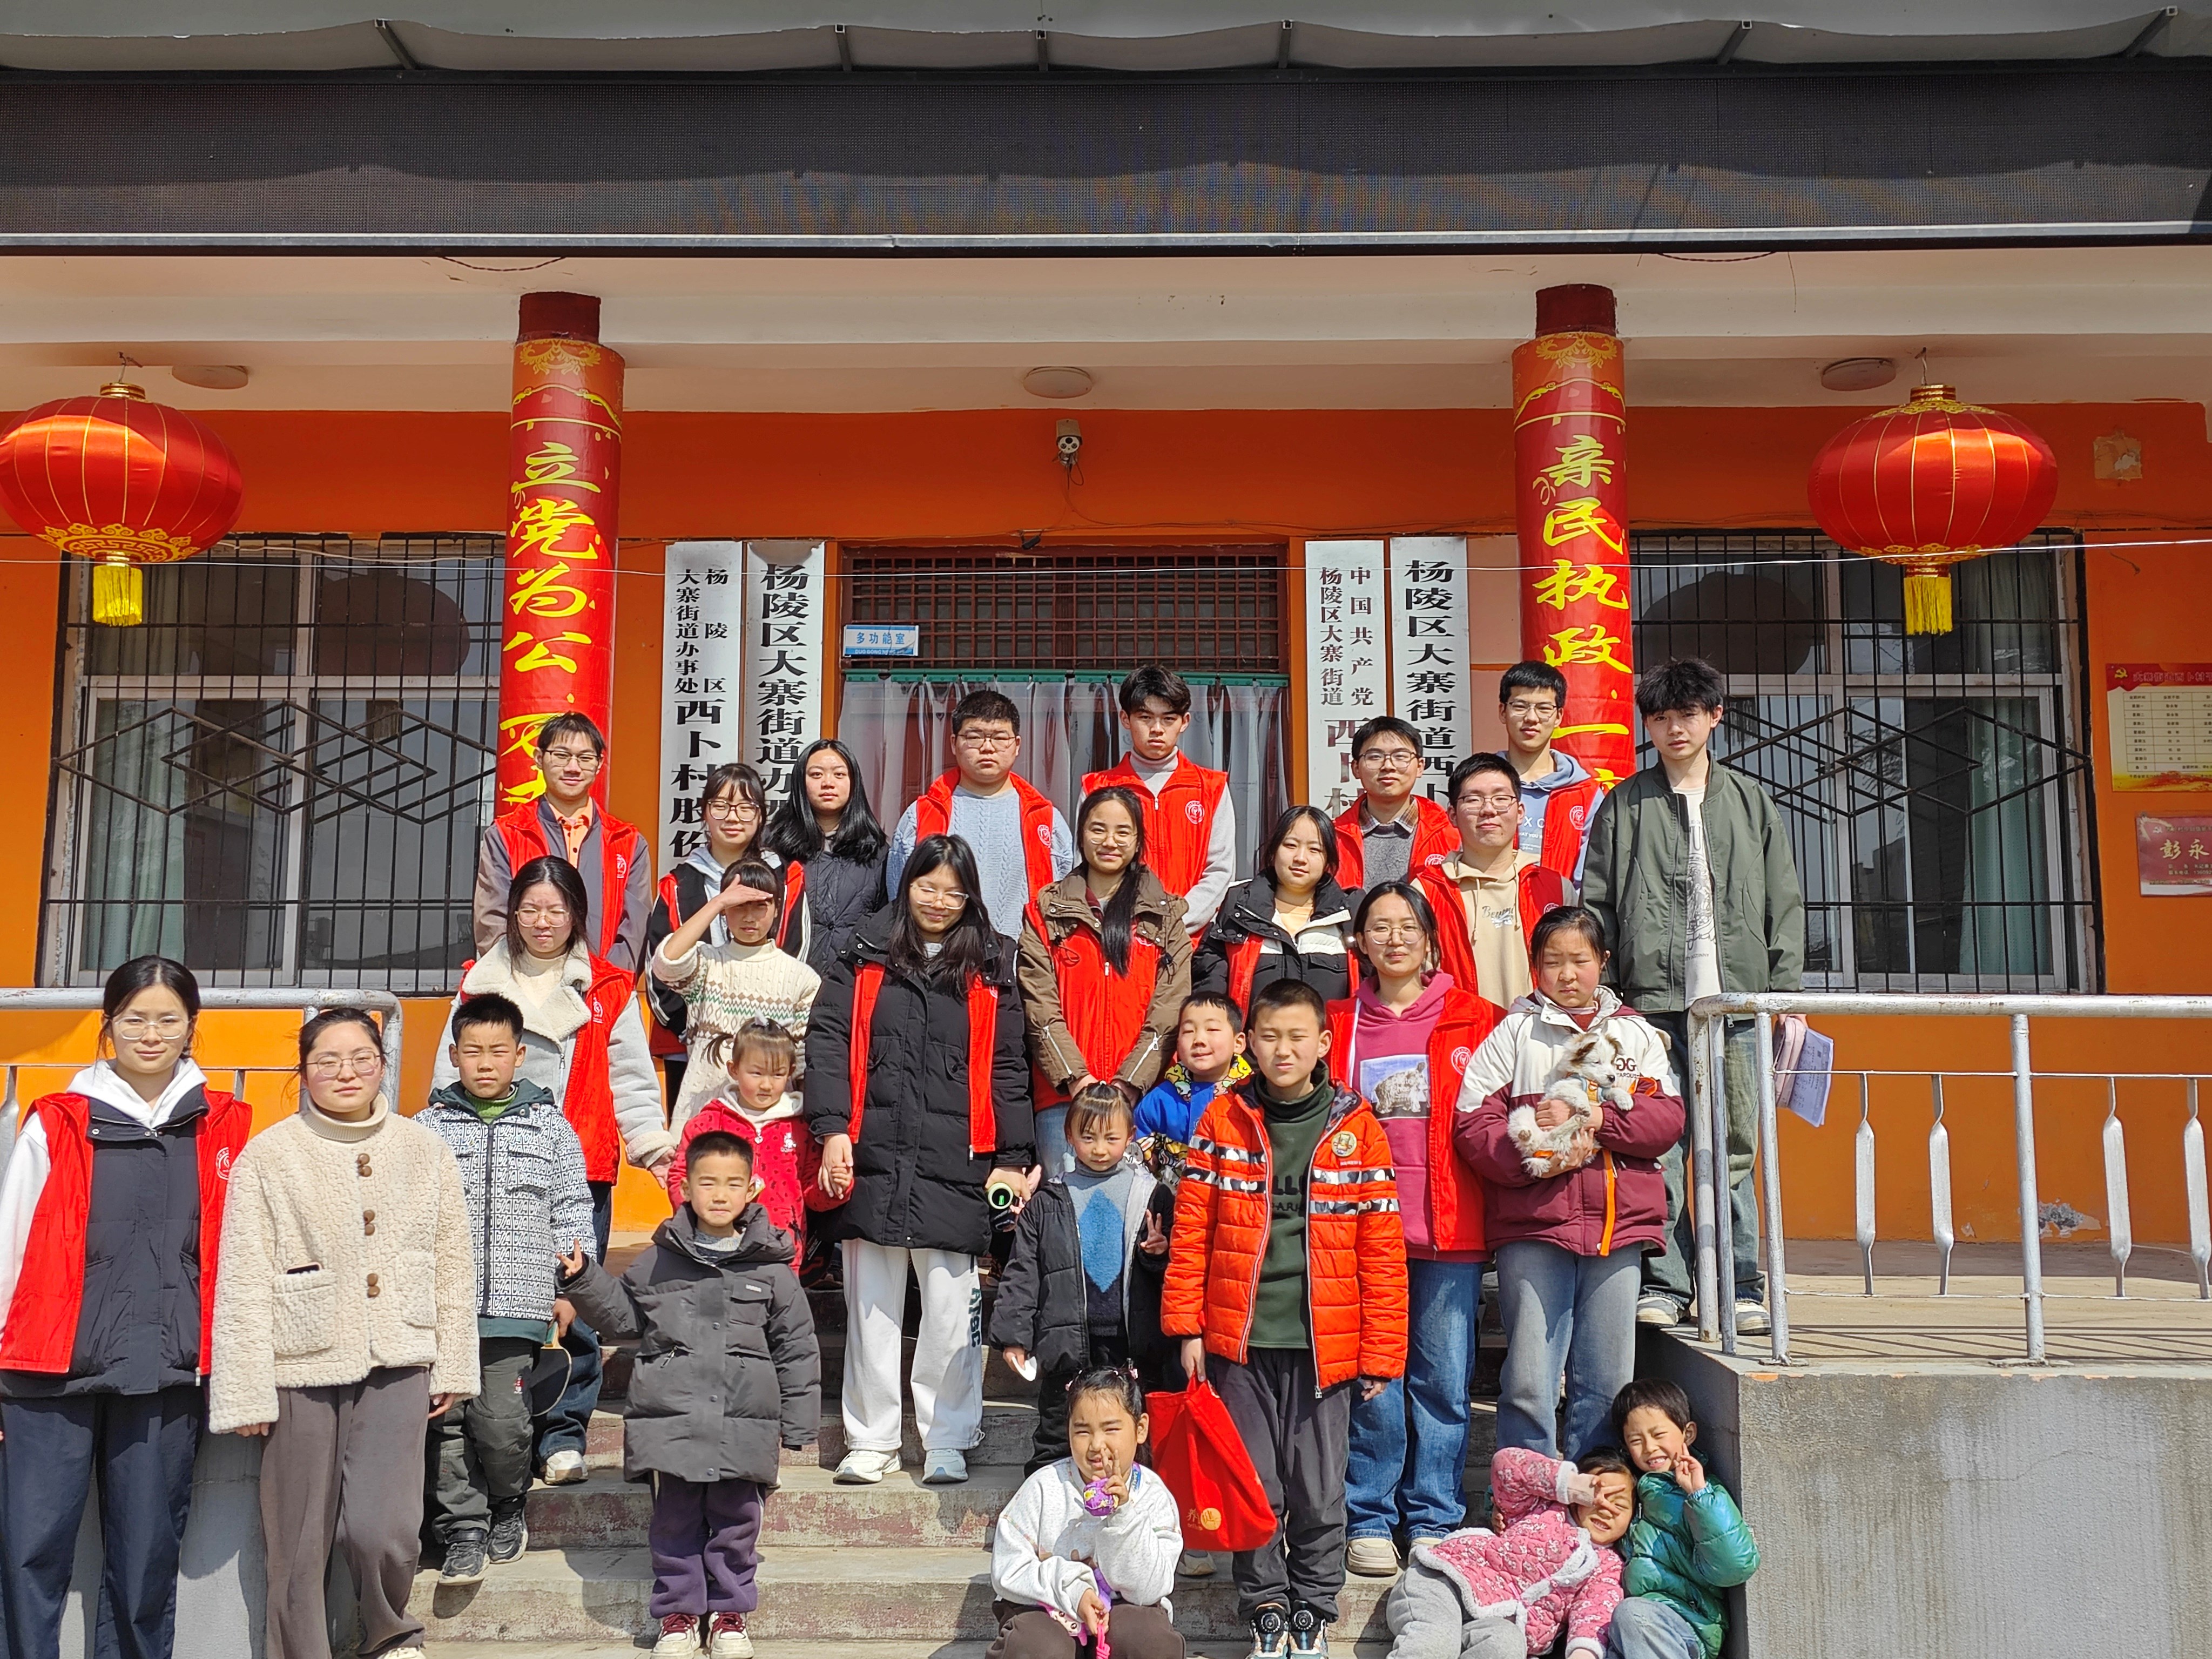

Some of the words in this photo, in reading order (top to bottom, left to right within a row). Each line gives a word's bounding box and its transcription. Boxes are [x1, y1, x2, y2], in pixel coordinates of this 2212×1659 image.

[503, 441, 601, 674] 立党为公
[1533, 435, 1633, 674] 亲民执政
[675, 569, 700, 694] 大寨街道办事处
[704, 569, 729, 693] 杨陵区
[857, 632, 905, 644] 多功能室
[1319, 567, 1344, 705] 杨陵区大寨街道
[1350, 567, 1374, 706] 中国共产党
[2160, 839, 2209, 860] 彭永
